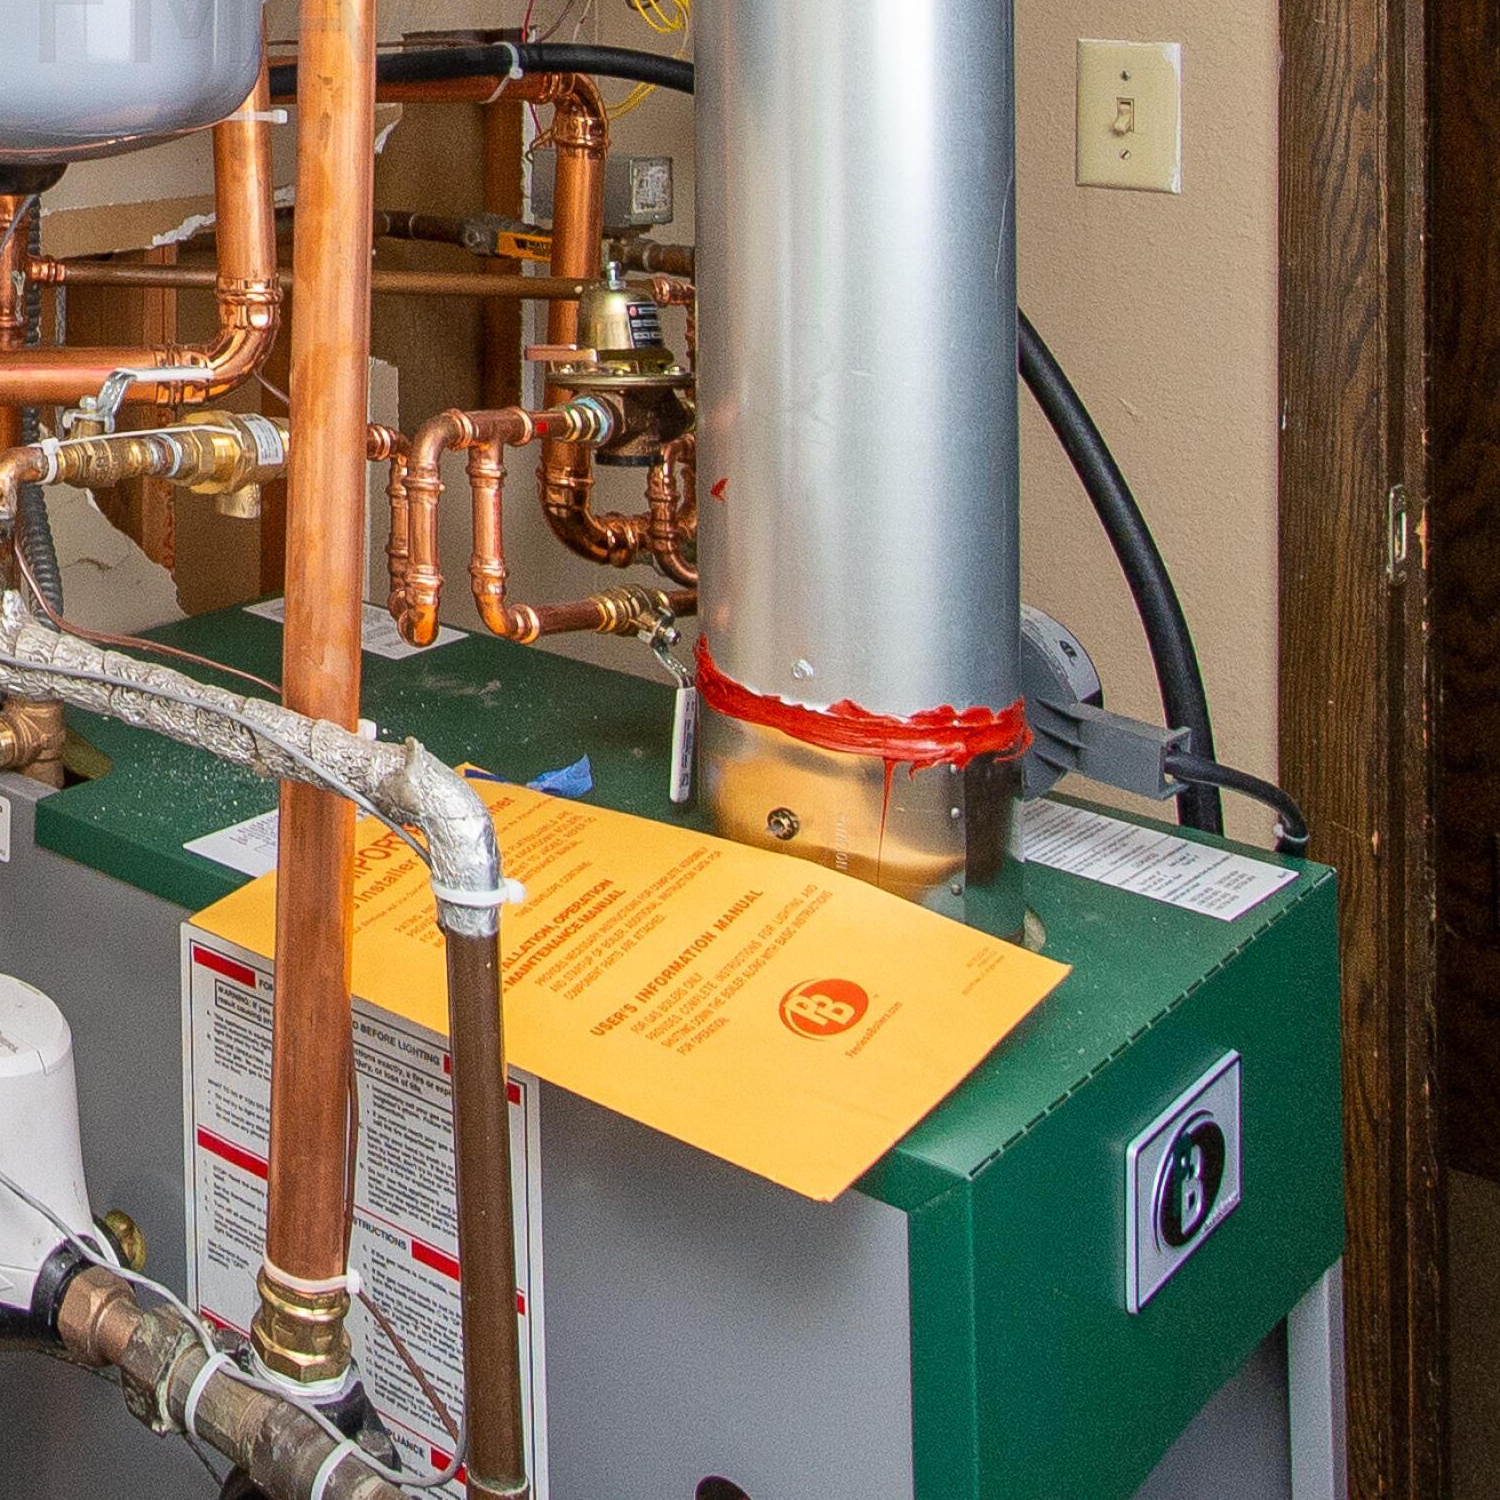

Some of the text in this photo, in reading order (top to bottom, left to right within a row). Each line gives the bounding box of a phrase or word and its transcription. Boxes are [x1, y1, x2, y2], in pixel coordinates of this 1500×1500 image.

[351, 858, 422, 902] Installer
[655, 870, 698, 901] INSTRUCTION
[494, 878, 615, 971] ALLATION, OPERATION
[498, 886, 628, 986] MAINTENANCE MANUAL
[595, 898, 644, 934] INSTRUCTIONS
[587, 887, 767, 1039] USER'S INFORMATION MANUAL
[597, 949, 626, 968] PARTS
[673, 979, 721, 1015] COMPLETE
[709, 939, 765, 982] INSTRUCTIONS
[753, 924, 780, 940] FOR
[768, 896, 808, 925] LIGHTING
[704, 995, 728, 1010] THE
[716, 976, 749, 999] BOILER
[770, 926, 799, 946] BASIC
[786, 889, 838, 928] INSTRUCTIONS
[218, 983, 248, 1006] WARNING:
[258, 1005, 270, 1017] you
[218, 994, 262, 1022] result causing
[654, 986, 690, 1012] BOILERS
[360, 1020, 439, 1069] BEFORE LIGHTING
[352, 1213, 406, 1251] STRUCTIONS
